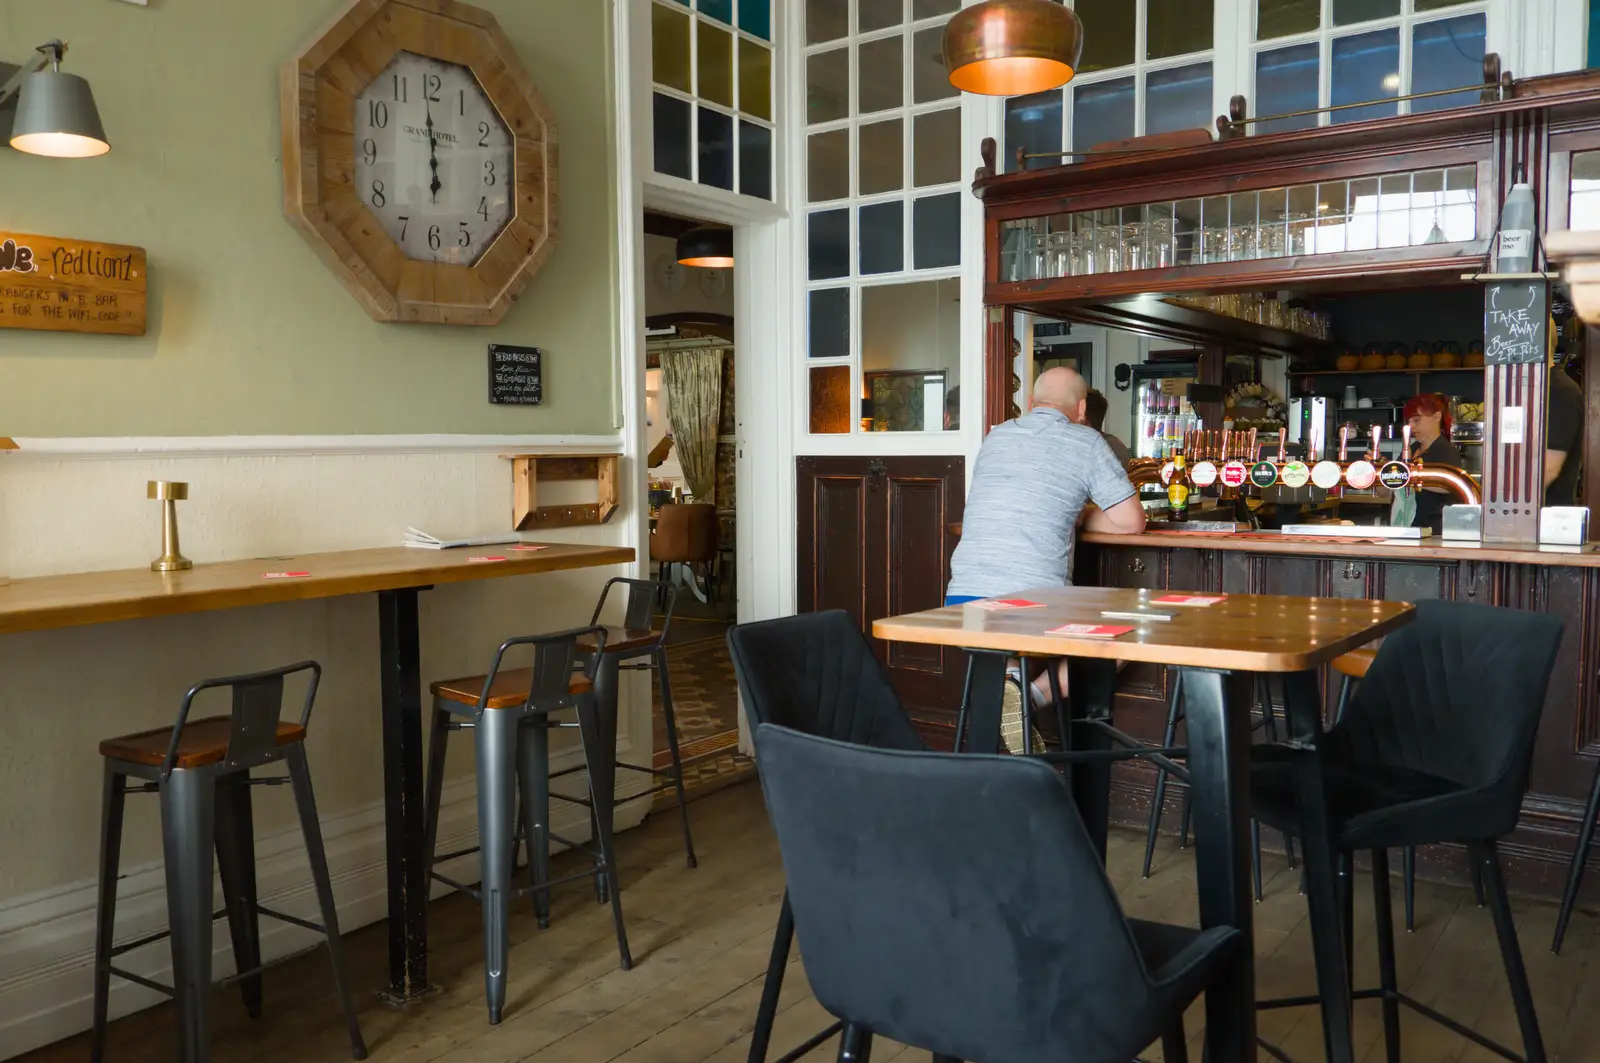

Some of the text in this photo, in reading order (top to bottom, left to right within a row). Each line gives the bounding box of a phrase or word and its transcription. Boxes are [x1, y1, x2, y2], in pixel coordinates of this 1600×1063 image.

[393, 75, 407, 103] 11
[423, 74, 442, 102] 12
[369, 100, 388, 129] 10
[459, 90, 465, 116] 1
[403, 125, 458, 144] GRAND HOTEL
[478, 121, 490, 147] 2
[363, 138, 377, 166] 9
[484, 161, 496, 186] 3
[372, 179, 386, 208] 8
[477, 196, 489, 221] 4
[398, 216, 409, 241] 7
[428, 225, 440, 250] 6
[459, 222, 470, 248] 5
[1502, 235, 1521, 243] beer
[13, 302, 33, 317] FOR
[40, 305, 62, 319] THE
[95, 293, 119, 308] BAR
[1489, 308, 1530, 328] TAKE
[1509, 321, 1541, 342] AWAY
[1487, 335, 1517, 356] Beer
[1498, 350, 1507, 361] 2
